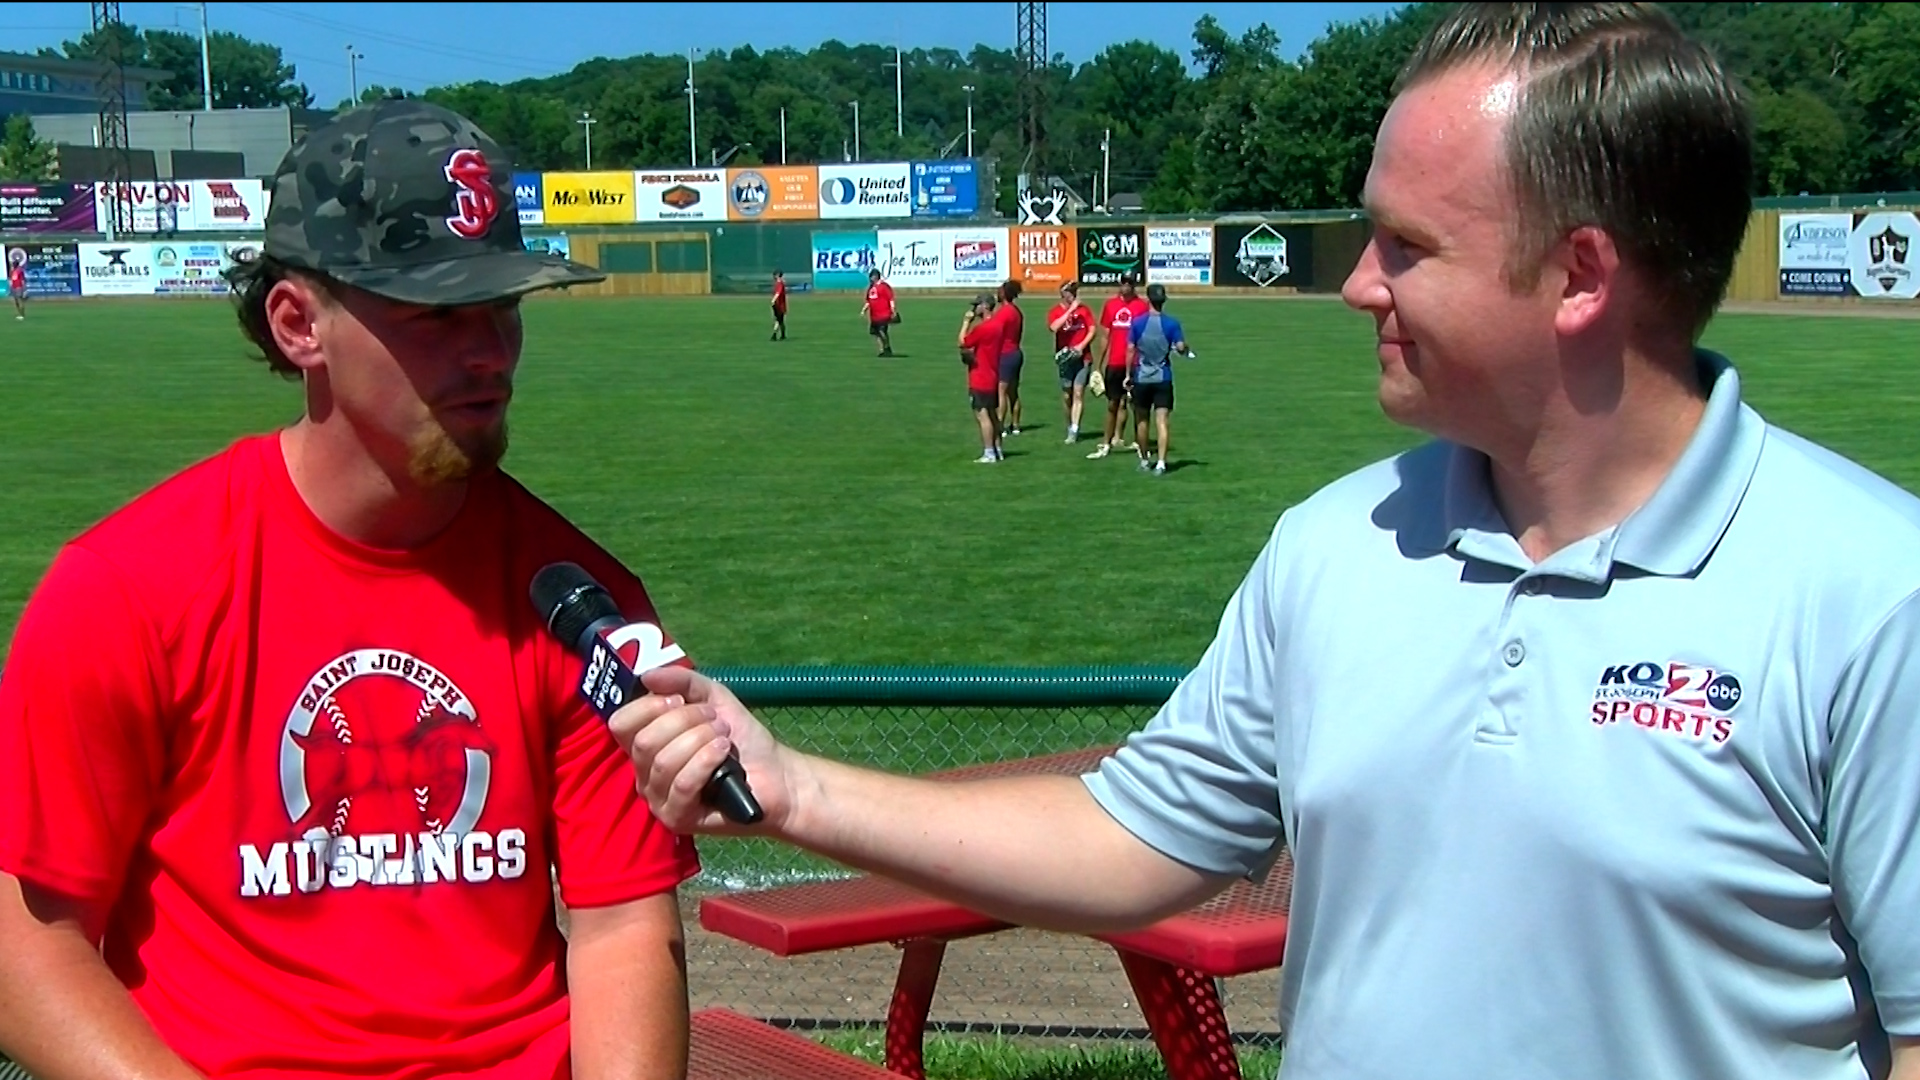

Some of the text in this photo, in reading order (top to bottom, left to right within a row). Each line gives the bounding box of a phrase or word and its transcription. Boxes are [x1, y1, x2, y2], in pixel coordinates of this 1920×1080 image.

[641, 173, 720, 184] FENCE FORMULA
[859, 176, 906, 189] United
[0, 197, 21, 206] Built
[859, 191, 910, 205] Rentals
[1018, 232, 1060, 247] HIT IT
[1102, 233, 1139, 254] C&M
[881, 241, 939, 279] Joe Town
[1018, 249, 1060, 265] HERE!
[85, 266, 115, 277] TOUGH
[120, 265, 150, 276] NAILS
[1789, 273, 1842, 283] COME DOWN
[606, 622, 687, 675] 2
[298, 653, 464, 713] SAINT JOSEPH
[596, 660, 618, 710] SPORTS
[1708, 684, 1740, 701] abc
[1592, 701, 1733, 743] SPORTS
[238, 827, 527, 897] MUSTANGS
